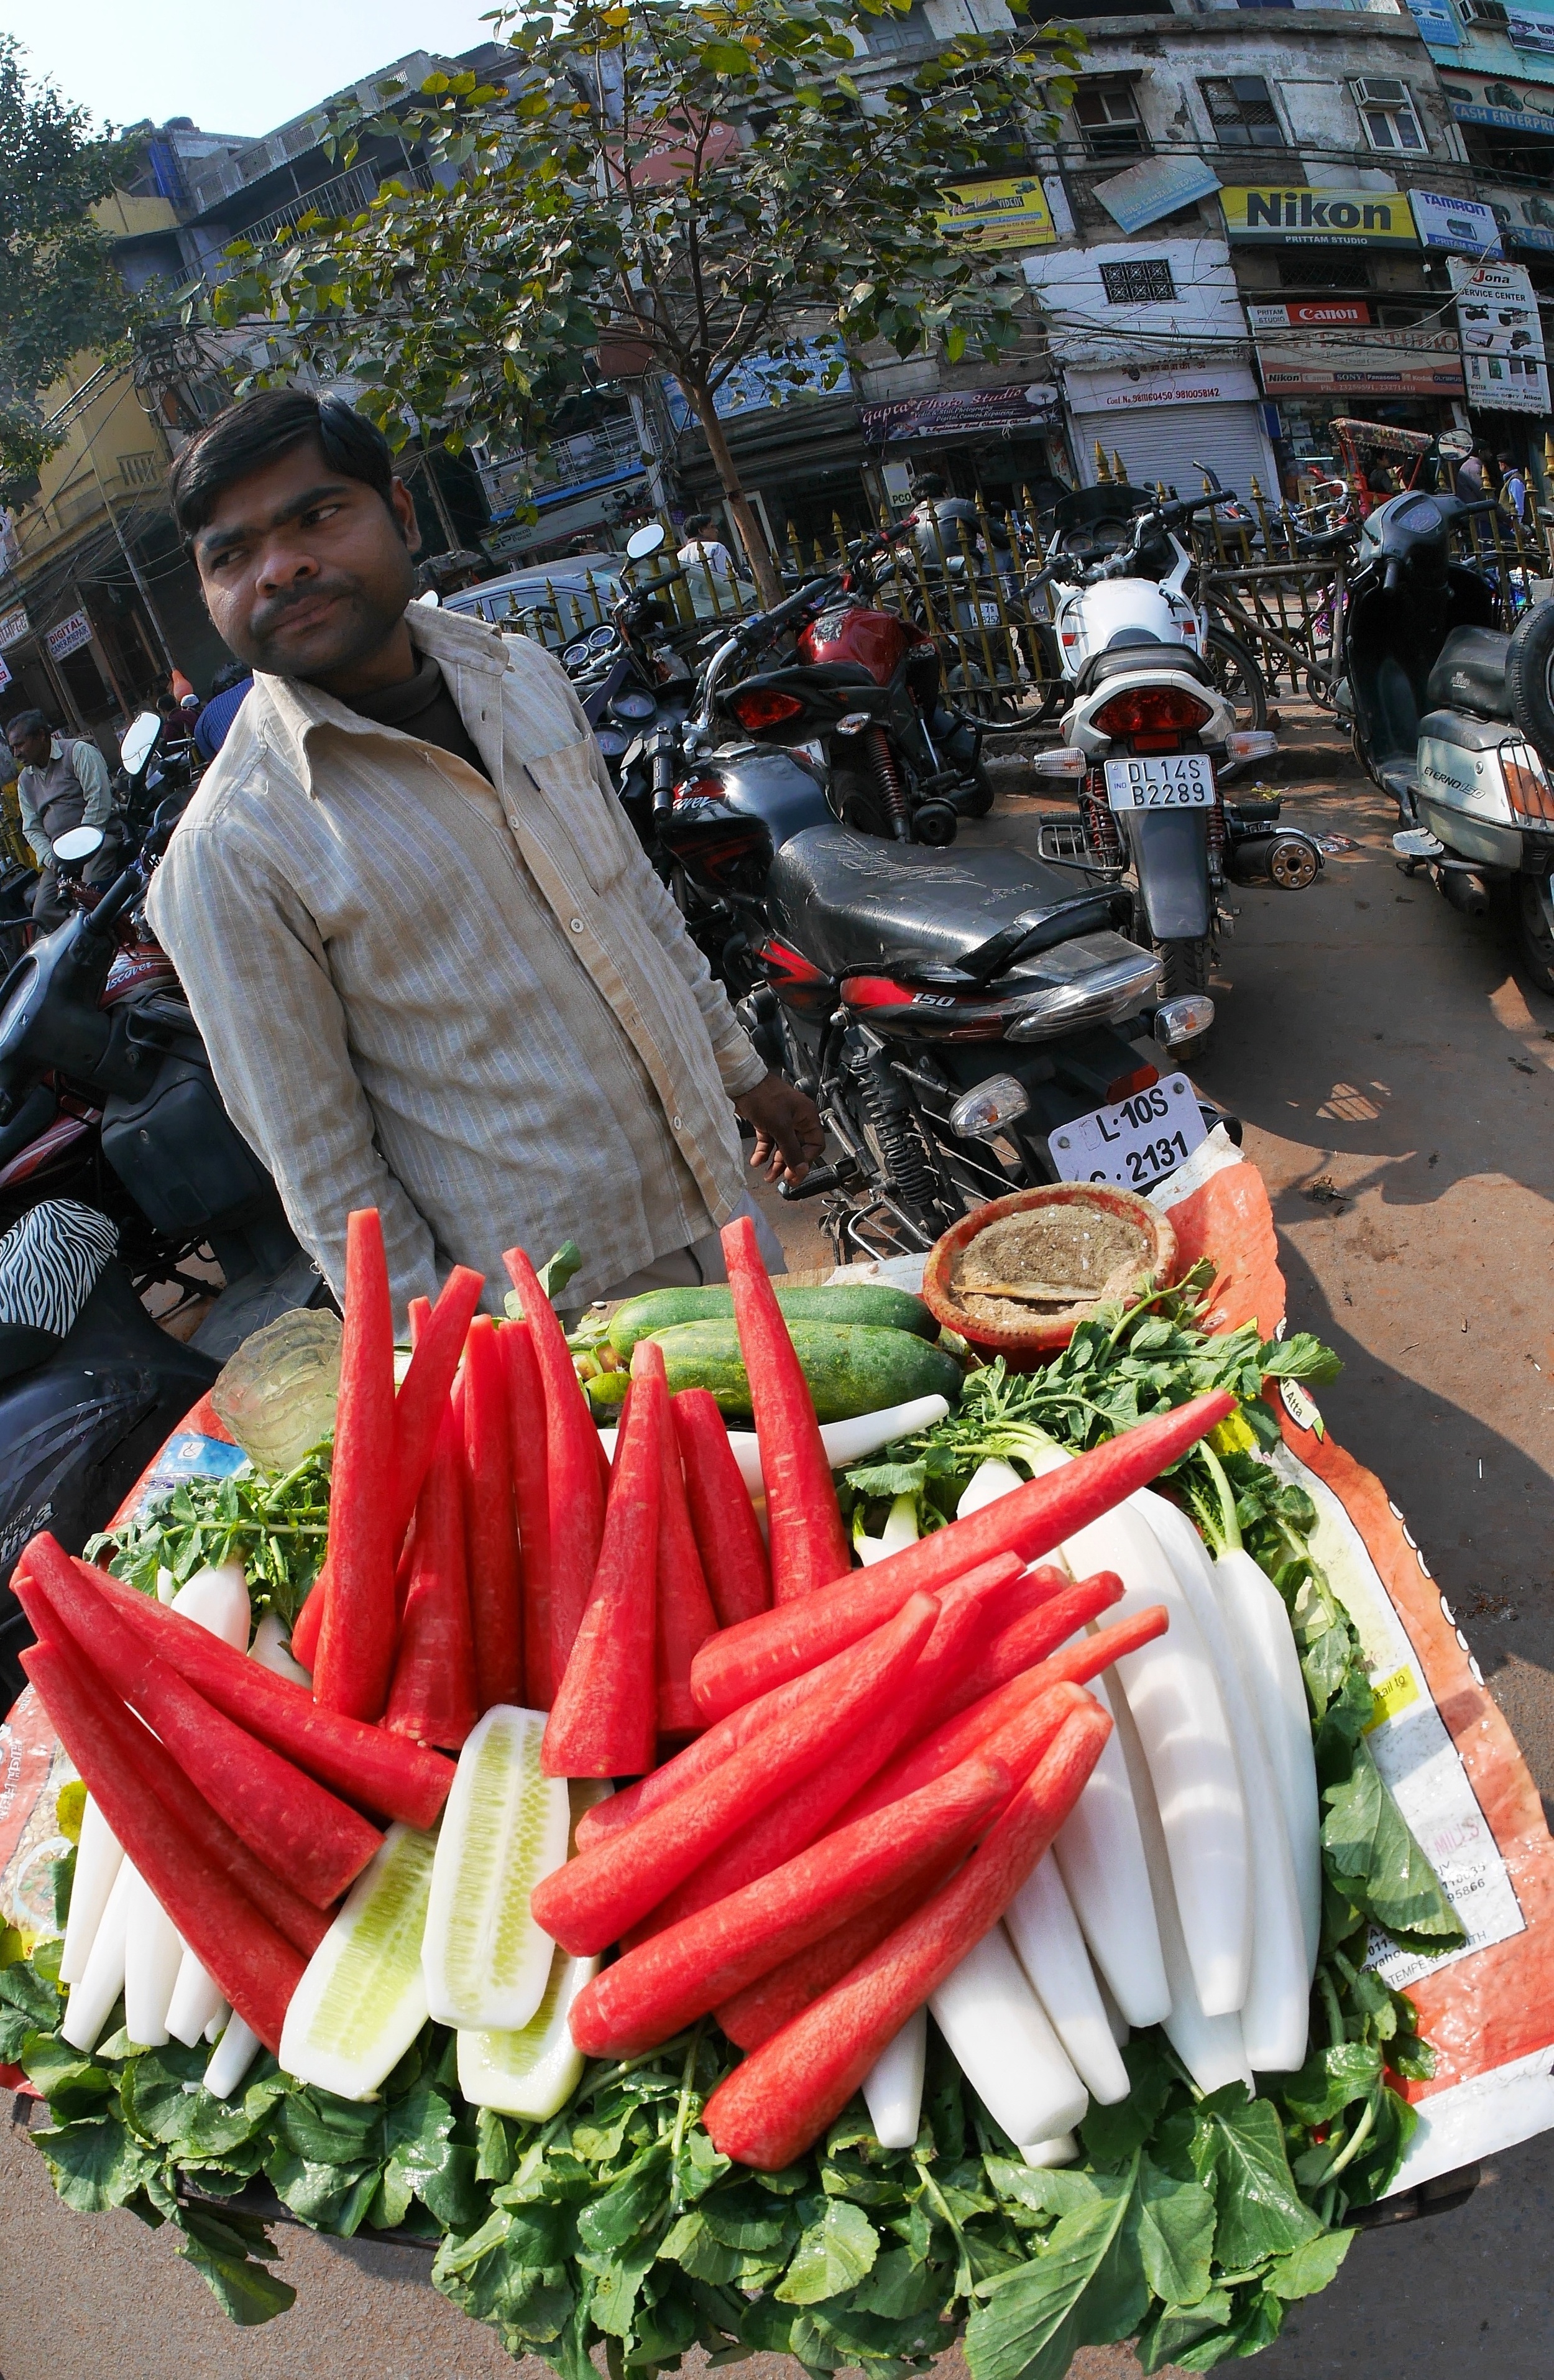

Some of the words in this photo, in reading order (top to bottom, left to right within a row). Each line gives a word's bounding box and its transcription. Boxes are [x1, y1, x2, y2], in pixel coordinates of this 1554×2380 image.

[997, 196, 1023, 208] VIDEOS
[1420, 193, 1486, 216] TAMRON
[1247, 192, 1391, 231] Nikon
[1285, 236, 1330, 244] PRITTAM
[1331, 236, 1368, 245] STUDIO
[1472, 269, 1510, 284] Jona
[1459, 288, 1493, 298] SERVICE
[1494, 291, 1526, 302] CENTER
[1258, 316, 1285, 324] STUDIO
[1299, 308, 1359, 321] Canon
[1269, 374, 1299, 382] Nikon
[1175, 387, 1220, 399] 9810058142
[862, 404, 909, 426] Gupta
[916, 397, 965, 411] Photo
[970, 387, 1021, 404] Studio
[892, 492, 912, 504] PCO
[512, 532, 532, 543] Power
[48, 618, 83, 645] DIGITAL
[1128, 759, 1200, 783] DL14S
[1114, 782, 1127, 790] IND
[1424, 766, 1462, 790] ETERNO
[1460, 782, 1486, 800] 150
[1131, 782, 1205, 806] B2289
[105, 961, 154, 992] iscover
[911, 992, 957, 1007] 150
[1285, 1391, 1303, 1418] Atta
[1394, 1674, 1406, 1685] to
[7, 1739, 23, 1782] HIGH
[1433, 1817, 1480, 1856] MILLS
[1446, 1878, 1486, 1903] 95866
